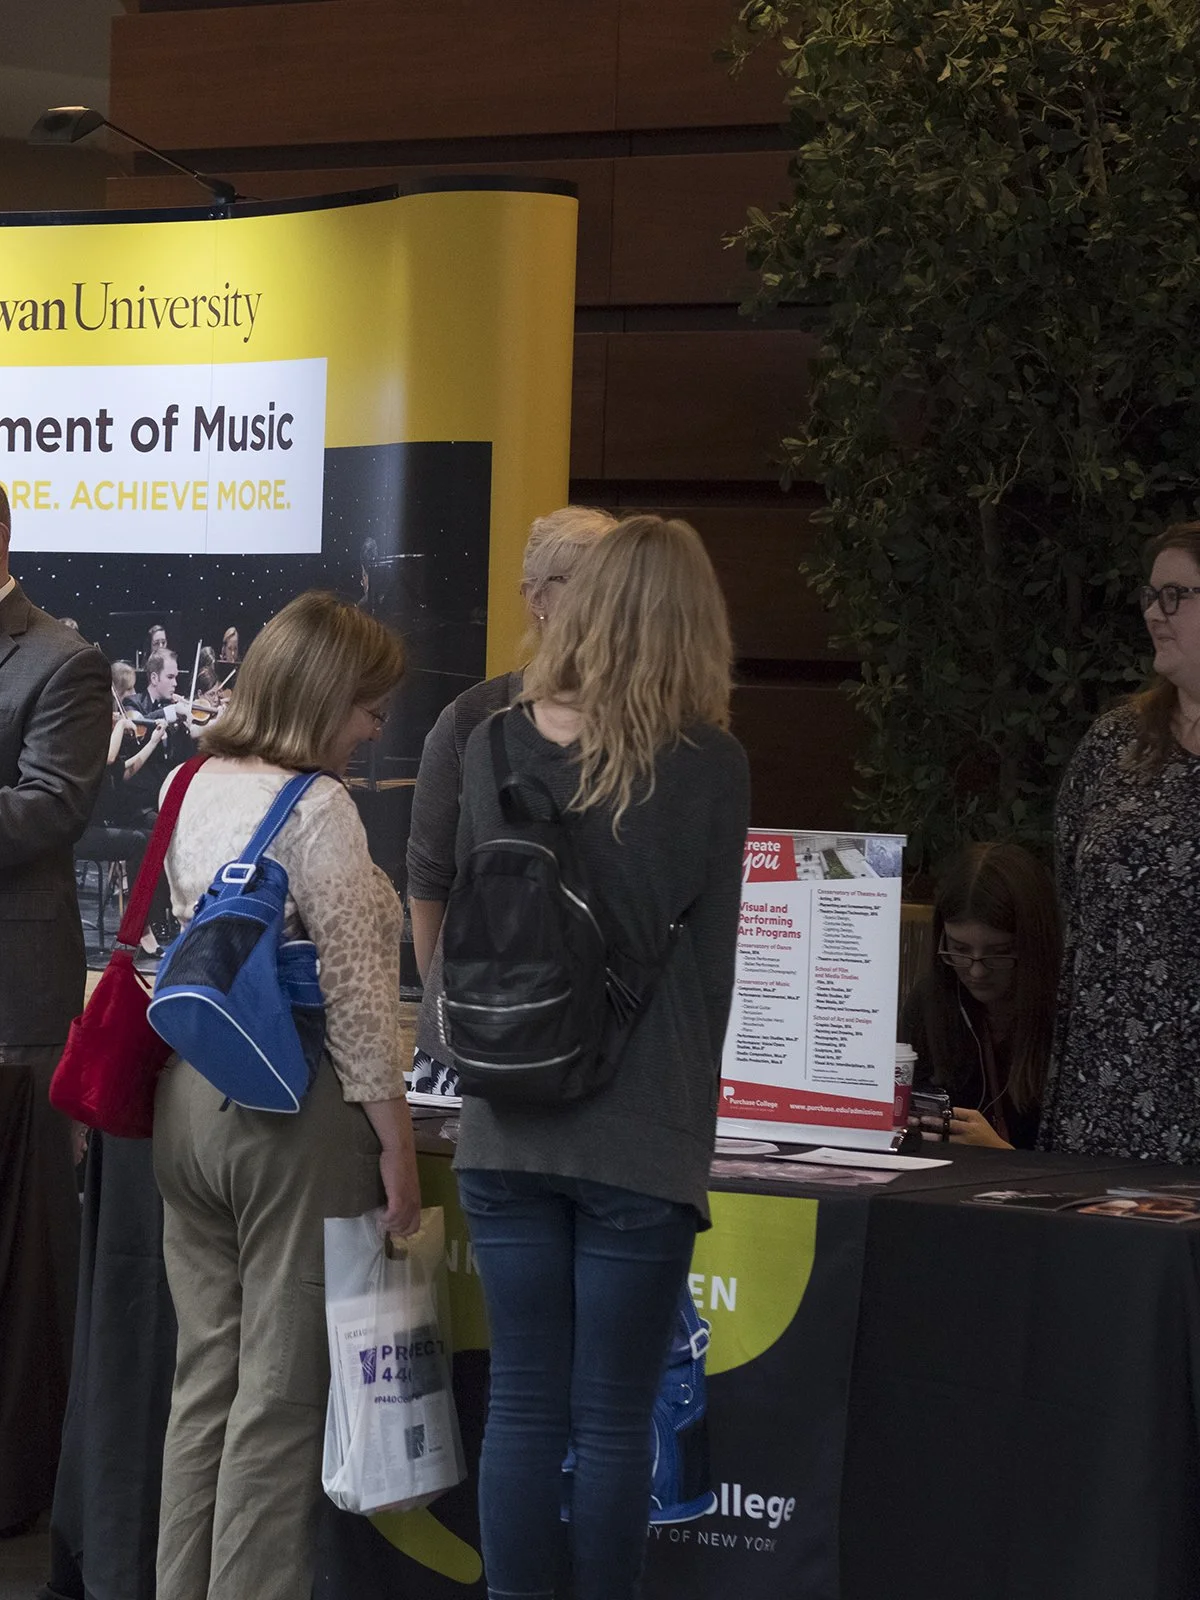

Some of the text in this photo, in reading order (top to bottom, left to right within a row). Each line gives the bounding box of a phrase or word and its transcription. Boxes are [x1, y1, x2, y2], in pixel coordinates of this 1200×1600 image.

[72, 281, 263, 343] University
[130, 403, 180, 453] of
[193, 401, 295, 452] Music
[0, 479, 60, 511] RE.
[69, 480, 208, 511] ACHIEVE
[217, 479, 291, 511] MORE.
[743, 840, 781, 852] reate
[740, 901, 788, 914] Visual and
[737, 926, 801, 940] Art Programs
[729, 1097, 755, 1106] Purchase
[755, 1099, 778, 1109] College
[688, 1273, 738, 1312] EN
[705, 1482, 796, 1530] llege
[669, 1528, 691, 1543] OF
[697, 1531, 738, 1548] NEW
[743, 1535, 778, 1552] YORK
